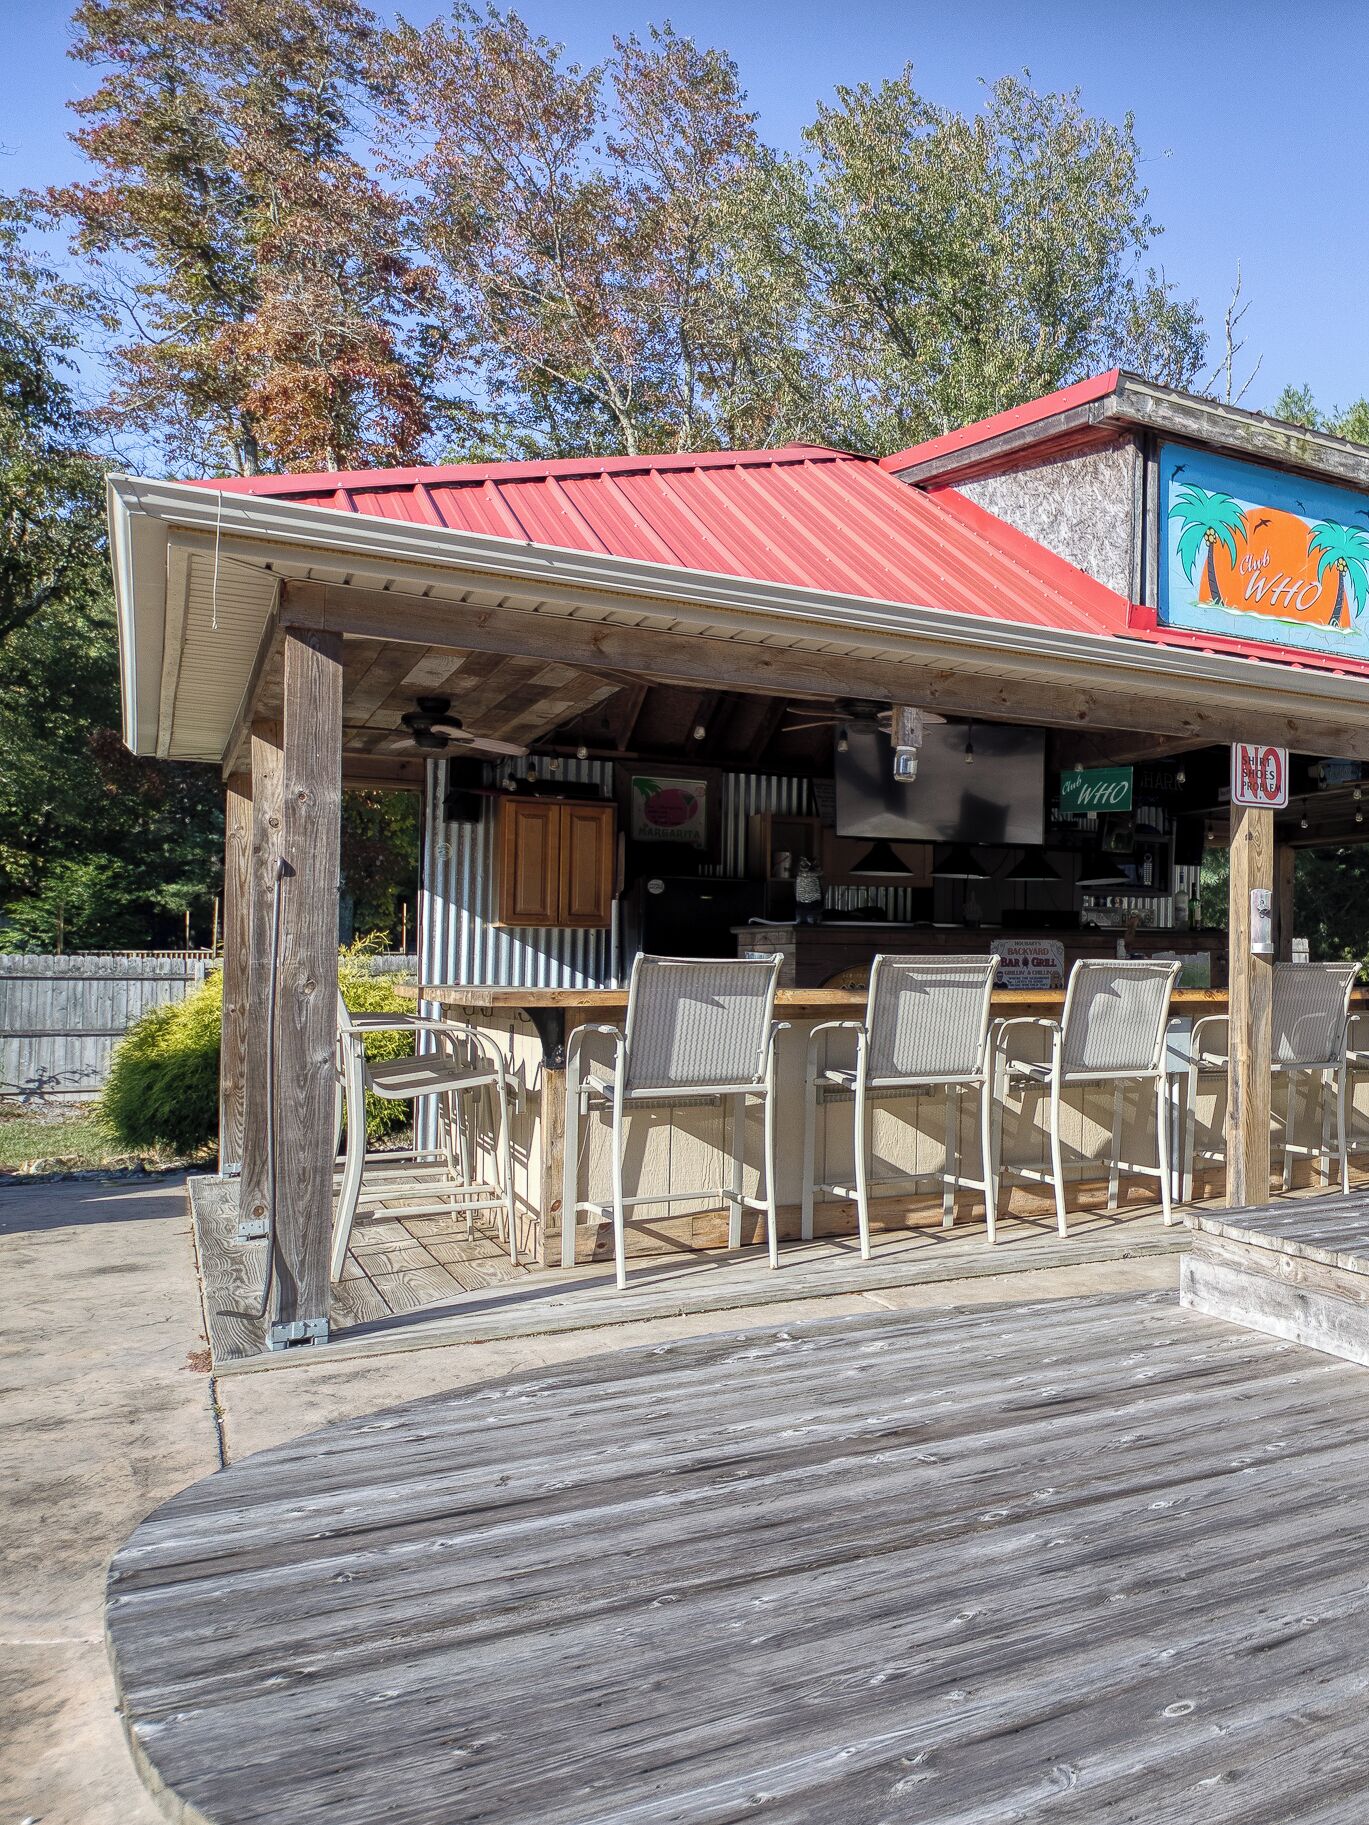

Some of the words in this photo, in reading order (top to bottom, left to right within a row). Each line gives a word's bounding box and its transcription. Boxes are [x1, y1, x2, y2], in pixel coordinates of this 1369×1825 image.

[1240, 549, 1270, 575] Club
[1245, 570, 1322, 611] WHO
[1242, 755, 1271, 767] SHIRT
[1240, 745, 1282, 801] NO
[1242, 768, 1275, 780] SHOES
[1062, 774, 1082, 796] Club
[1077, 781, 1129, 805] WHO
[1242, 781, 1282, 793] PROBLEM
[1007, 947, 1049, 956] BACKYARD
[1000, 956, 1020, 967] BAR
[1031, 956, 1057, 967] GRILL
